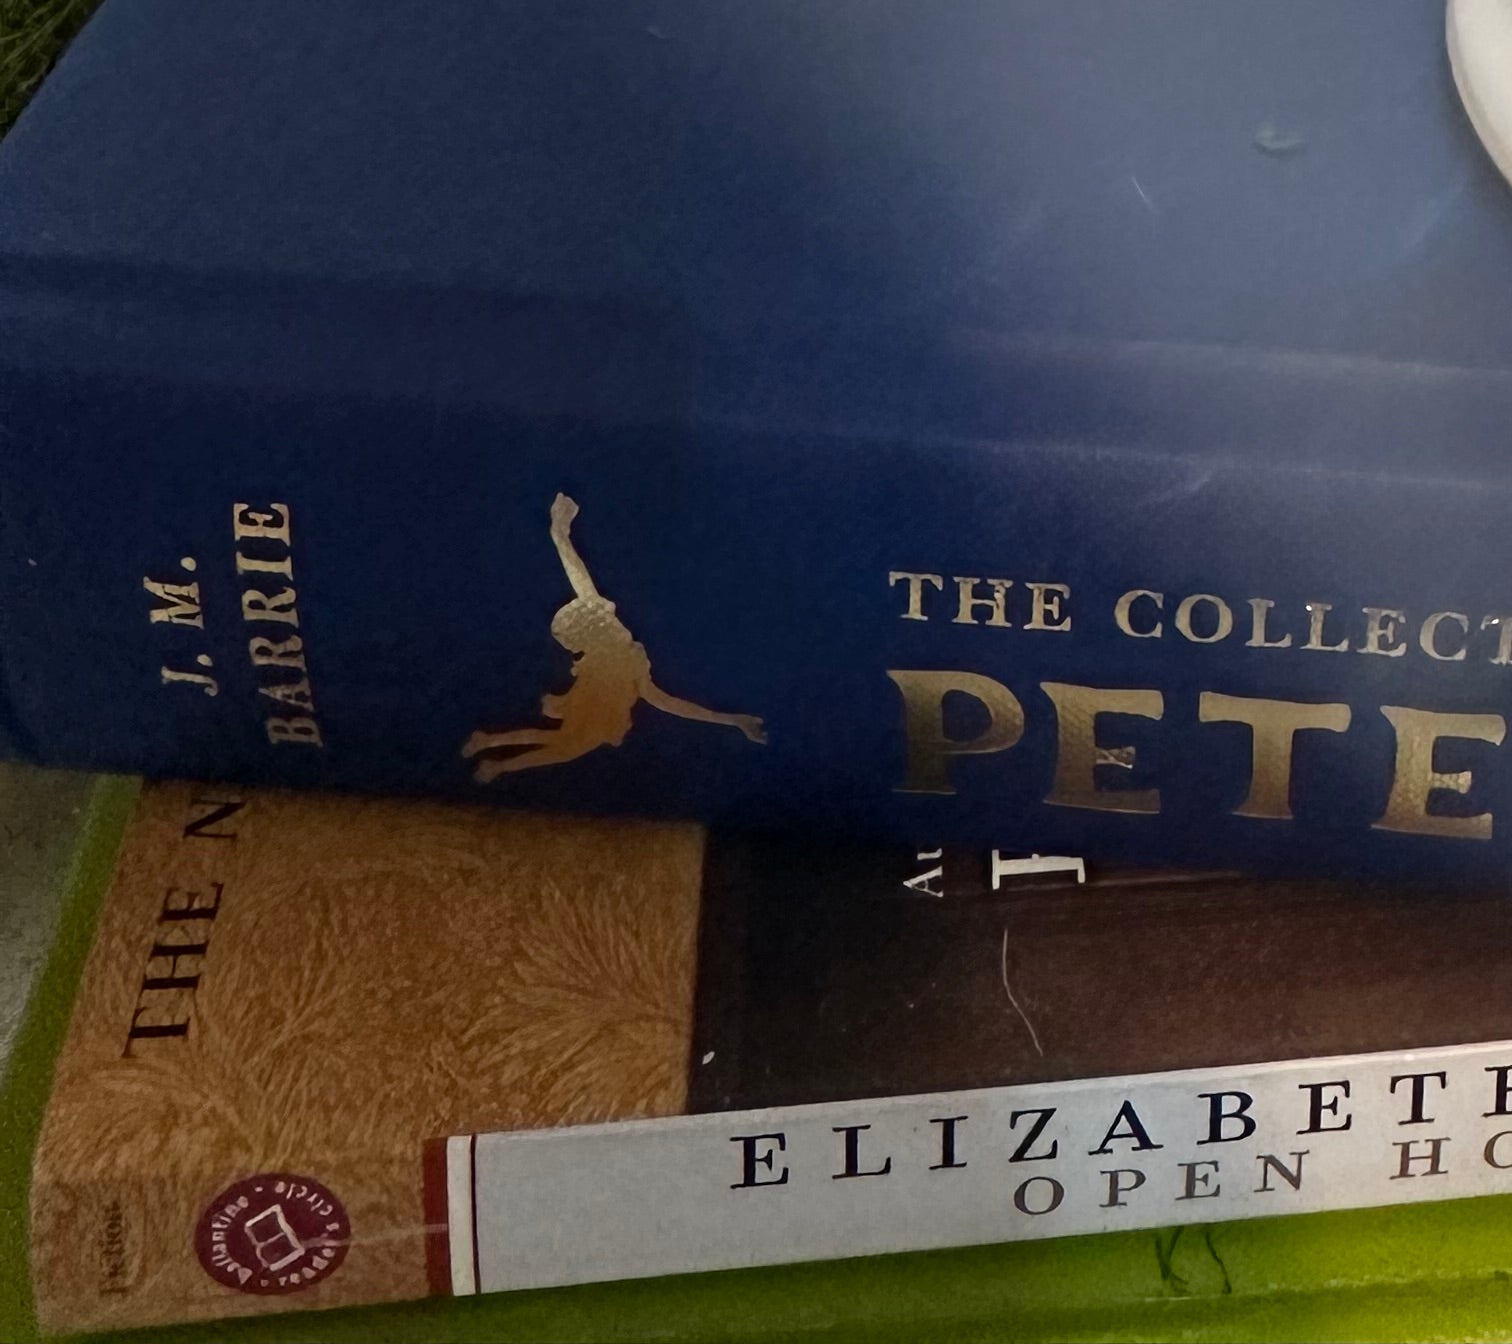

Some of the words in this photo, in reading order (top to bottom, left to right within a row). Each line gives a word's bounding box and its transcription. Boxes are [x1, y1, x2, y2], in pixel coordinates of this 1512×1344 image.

[142, 556, 205, 630] M.
[233, 502, 324, 747] BARRIE
[888, 570, 1073, 632] THE
[160, 654, 218, 697] J.
[121, 883, 225, 1058] THE
[1012, 1150, 1309, 1216] OPEN
